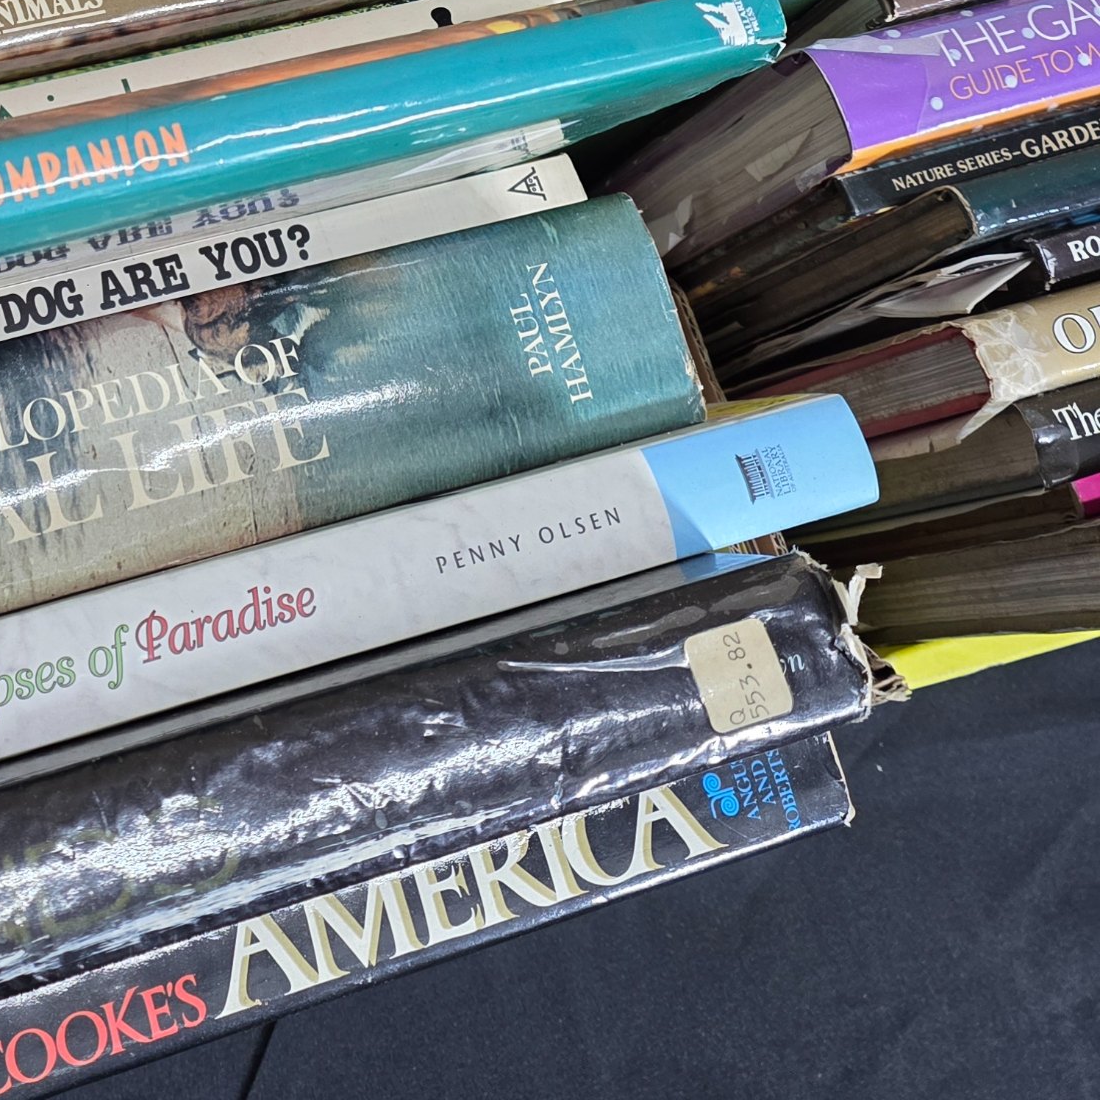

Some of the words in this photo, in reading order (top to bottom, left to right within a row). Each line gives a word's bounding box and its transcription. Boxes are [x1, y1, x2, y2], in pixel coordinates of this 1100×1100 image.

[921, 15, 1026, 67] THE
[950, 59, 1035, 100] GUIDE
[1032, 49, 1074, 77] TO
[891, 162, 956, 192] NATURE
[99, 252, 191, 310] ARE
[199, 225, 311, 282] YOU?
[510, 292, 554, 377] PAUL
[526, 262, 593, 404] HAMLYN
[234, 335, 300, 386] OF
[110, 387, 330, 511] LIFE
[761, 447, 783, 497] NATIONAL
[768, 446, 791, 494] LIBRARY
[88, 624, 130, 690] of
[135, 585, 317, 665] Paradise
[435, 534, 523, 574] PENNY
[537, 506, 623, 545] OLSEN
[723, 631, 769, 719] 553.82
[730, 710, 744, 724] Q
[750, 760, 777, 805] AND
[214, 784, 729, 1021] AMERICA
